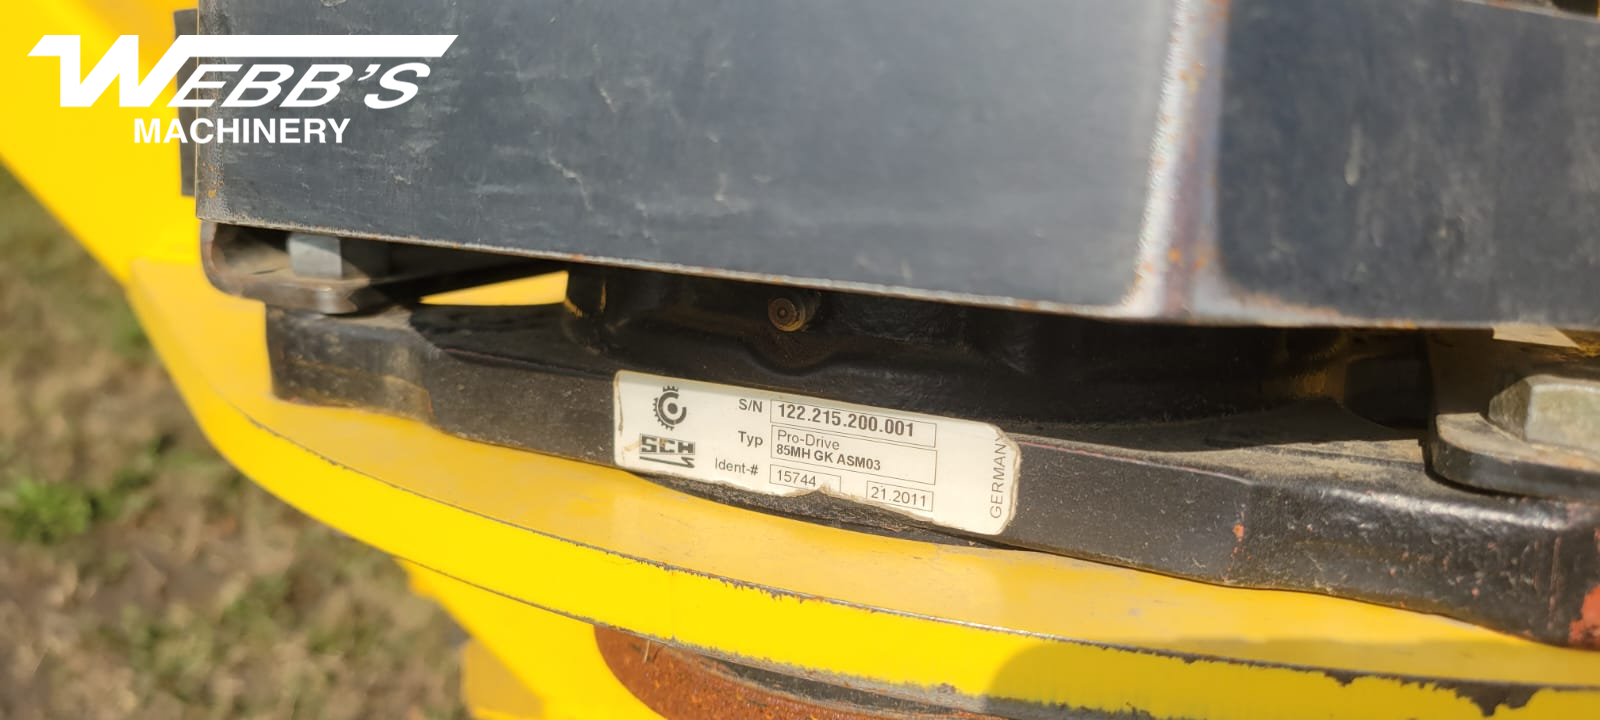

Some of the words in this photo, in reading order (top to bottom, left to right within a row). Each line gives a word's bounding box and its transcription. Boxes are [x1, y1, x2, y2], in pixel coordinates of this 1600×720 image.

[738, 398, 763, 413] S/N
[778, 403, 915, 437] 122.215.200.001
[738, 430, 764, 447] Typ
[777, 429, 841, 451] Pro-Drive
[714, 456, 759, 477] Ident-#
[776, 444, 811, 461] 85MH
[813, 449, 834, 464] GK
[836, 453, 882, 471] ASM03
[776, 469, 817, 488] 15744
[871, 487, 926, 507] 21.2011
